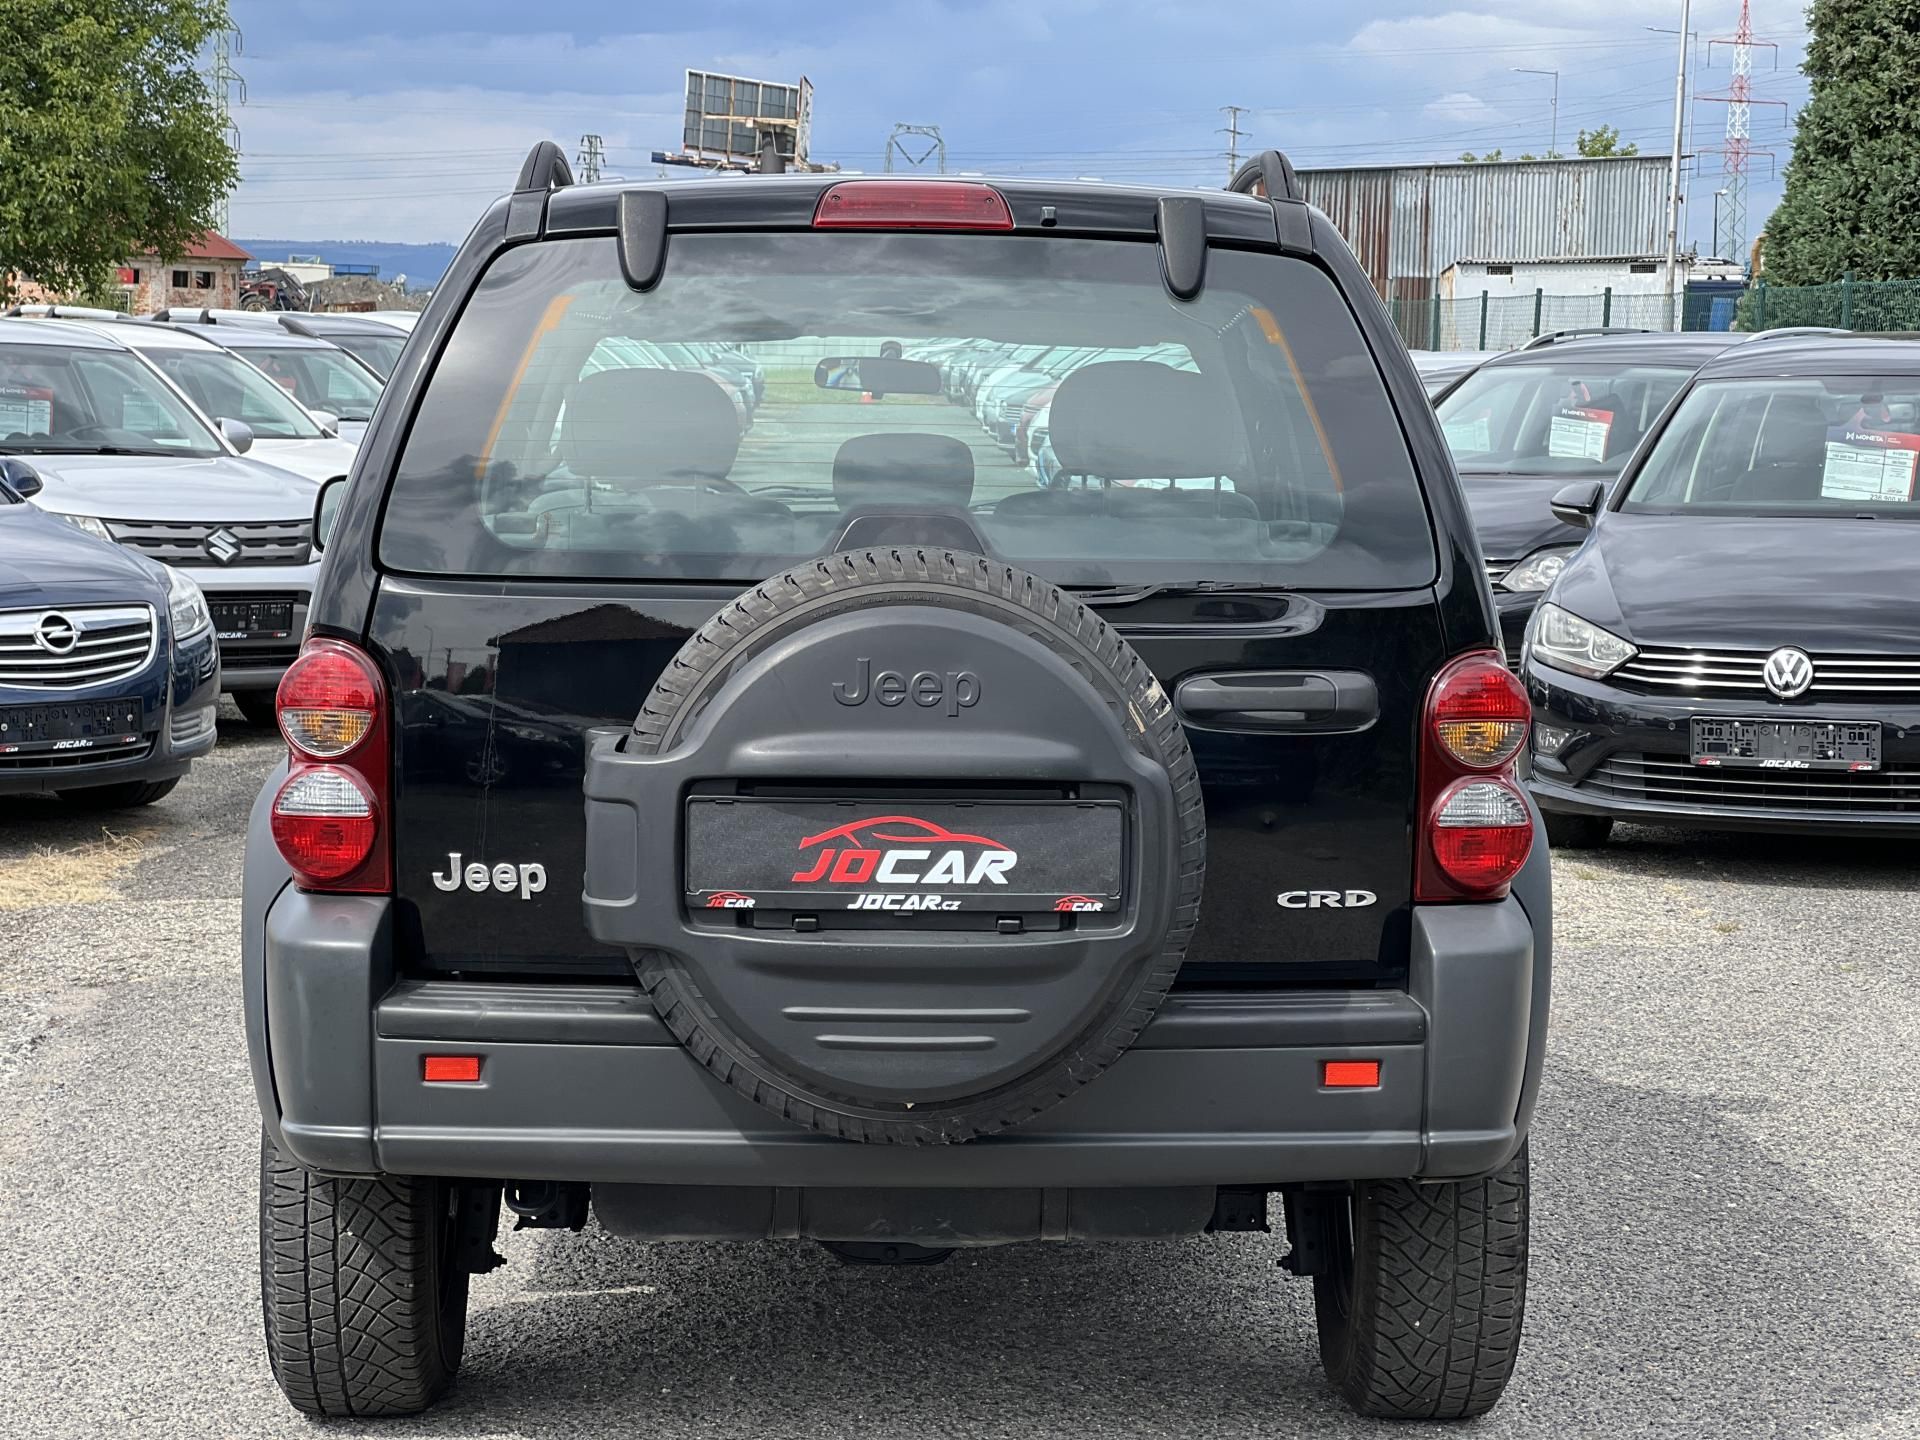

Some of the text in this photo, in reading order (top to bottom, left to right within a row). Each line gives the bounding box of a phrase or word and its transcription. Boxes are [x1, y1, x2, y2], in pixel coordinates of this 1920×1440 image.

[1855, 434, 1884, 442] MONETA
[832, 657, 982, 718] Jeep
[432, 852, 547, 899] Jeep
[792, 848, 1018, 885] JOCAR
[706, 897, 756, 908] JOCAR
[847, 894, 962, 911] JOCAR.cz
[1054, 901, 1104, 912] JOCAR
[1277, 889, 1378, 909] CRD
